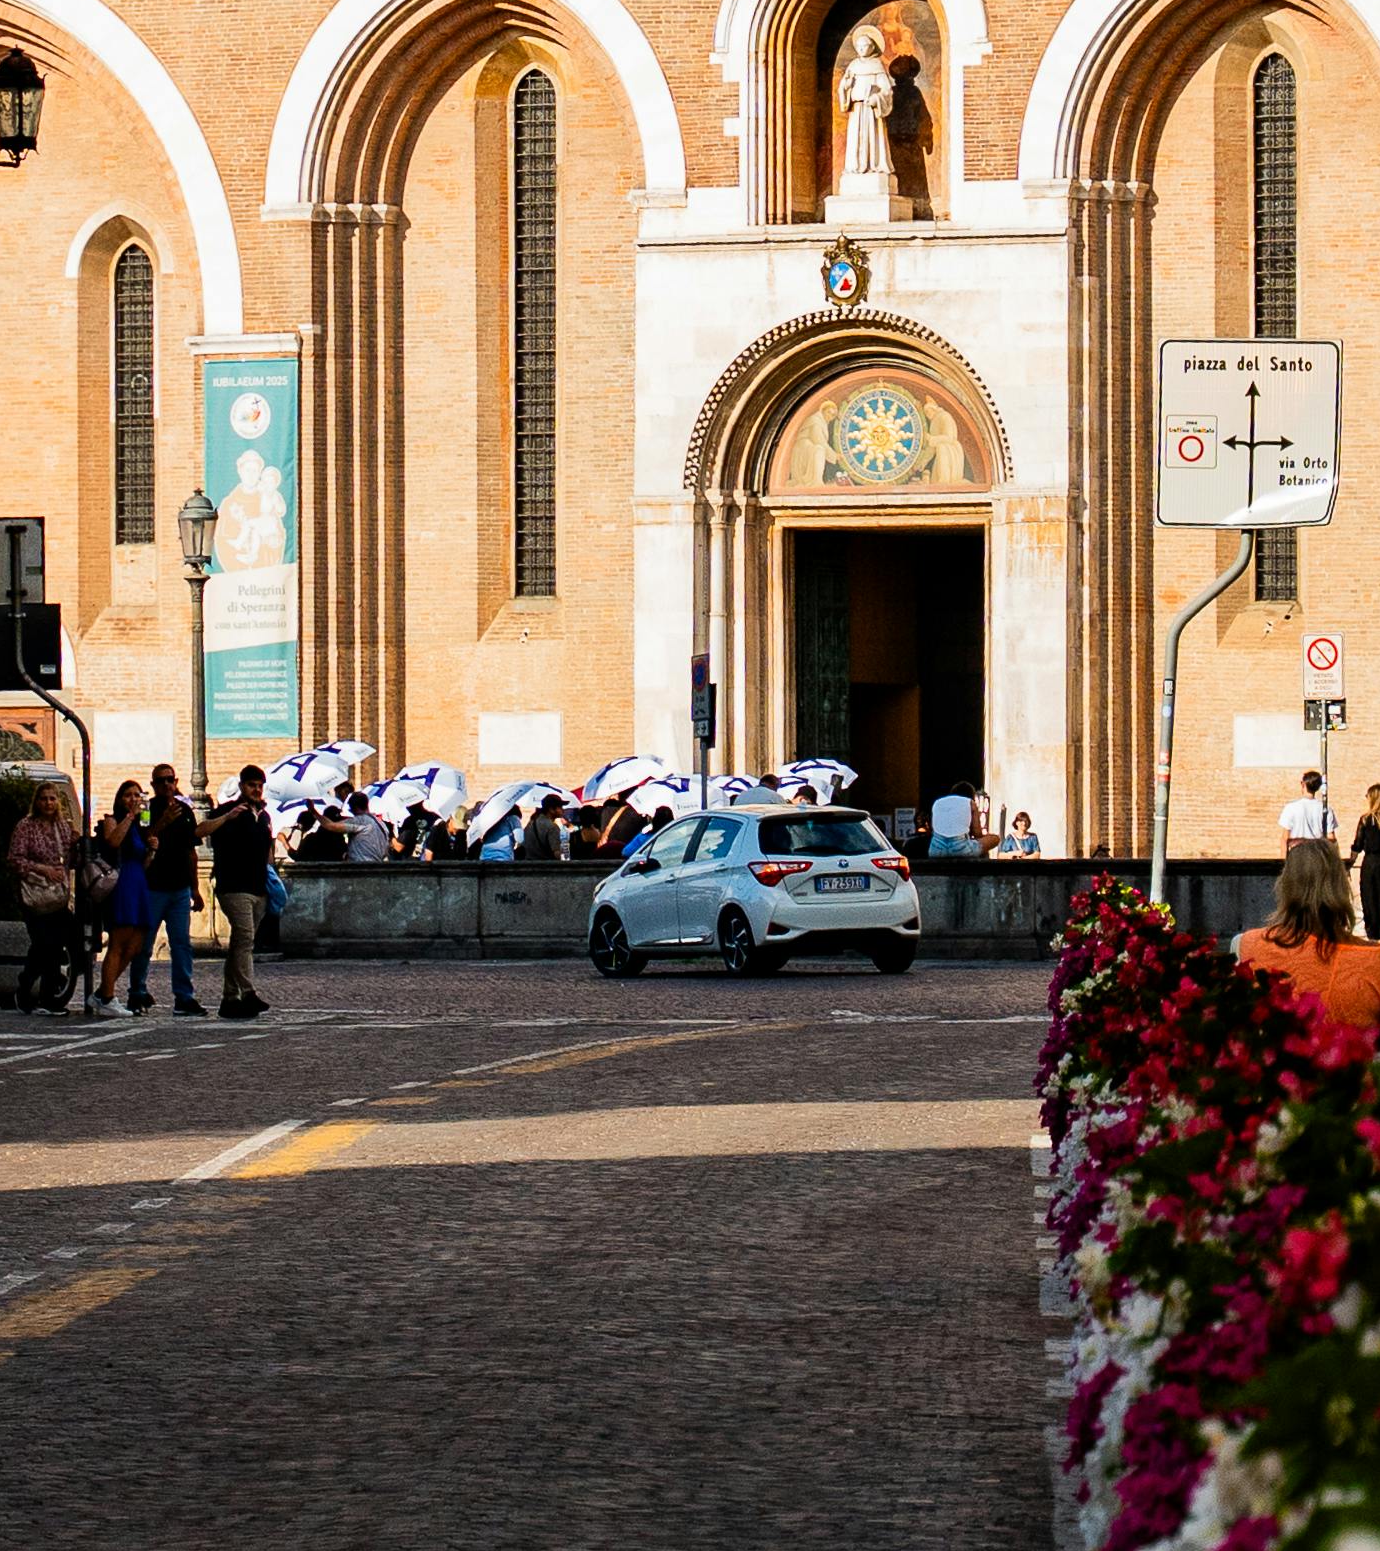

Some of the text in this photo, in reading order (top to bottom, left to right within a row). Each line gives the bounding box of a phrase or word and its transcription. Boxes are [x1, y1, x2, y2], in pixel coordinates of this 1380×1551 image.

[1184, 355, 1313, 373] piazza del Santo
[212, 376, 288, 388] IUBILAEUM 2025
[1279, 456, 1328, 469] via Orto
[238, 584, 286, 598] Pellegrini
[227, 602, 286, 615] di Speranza
